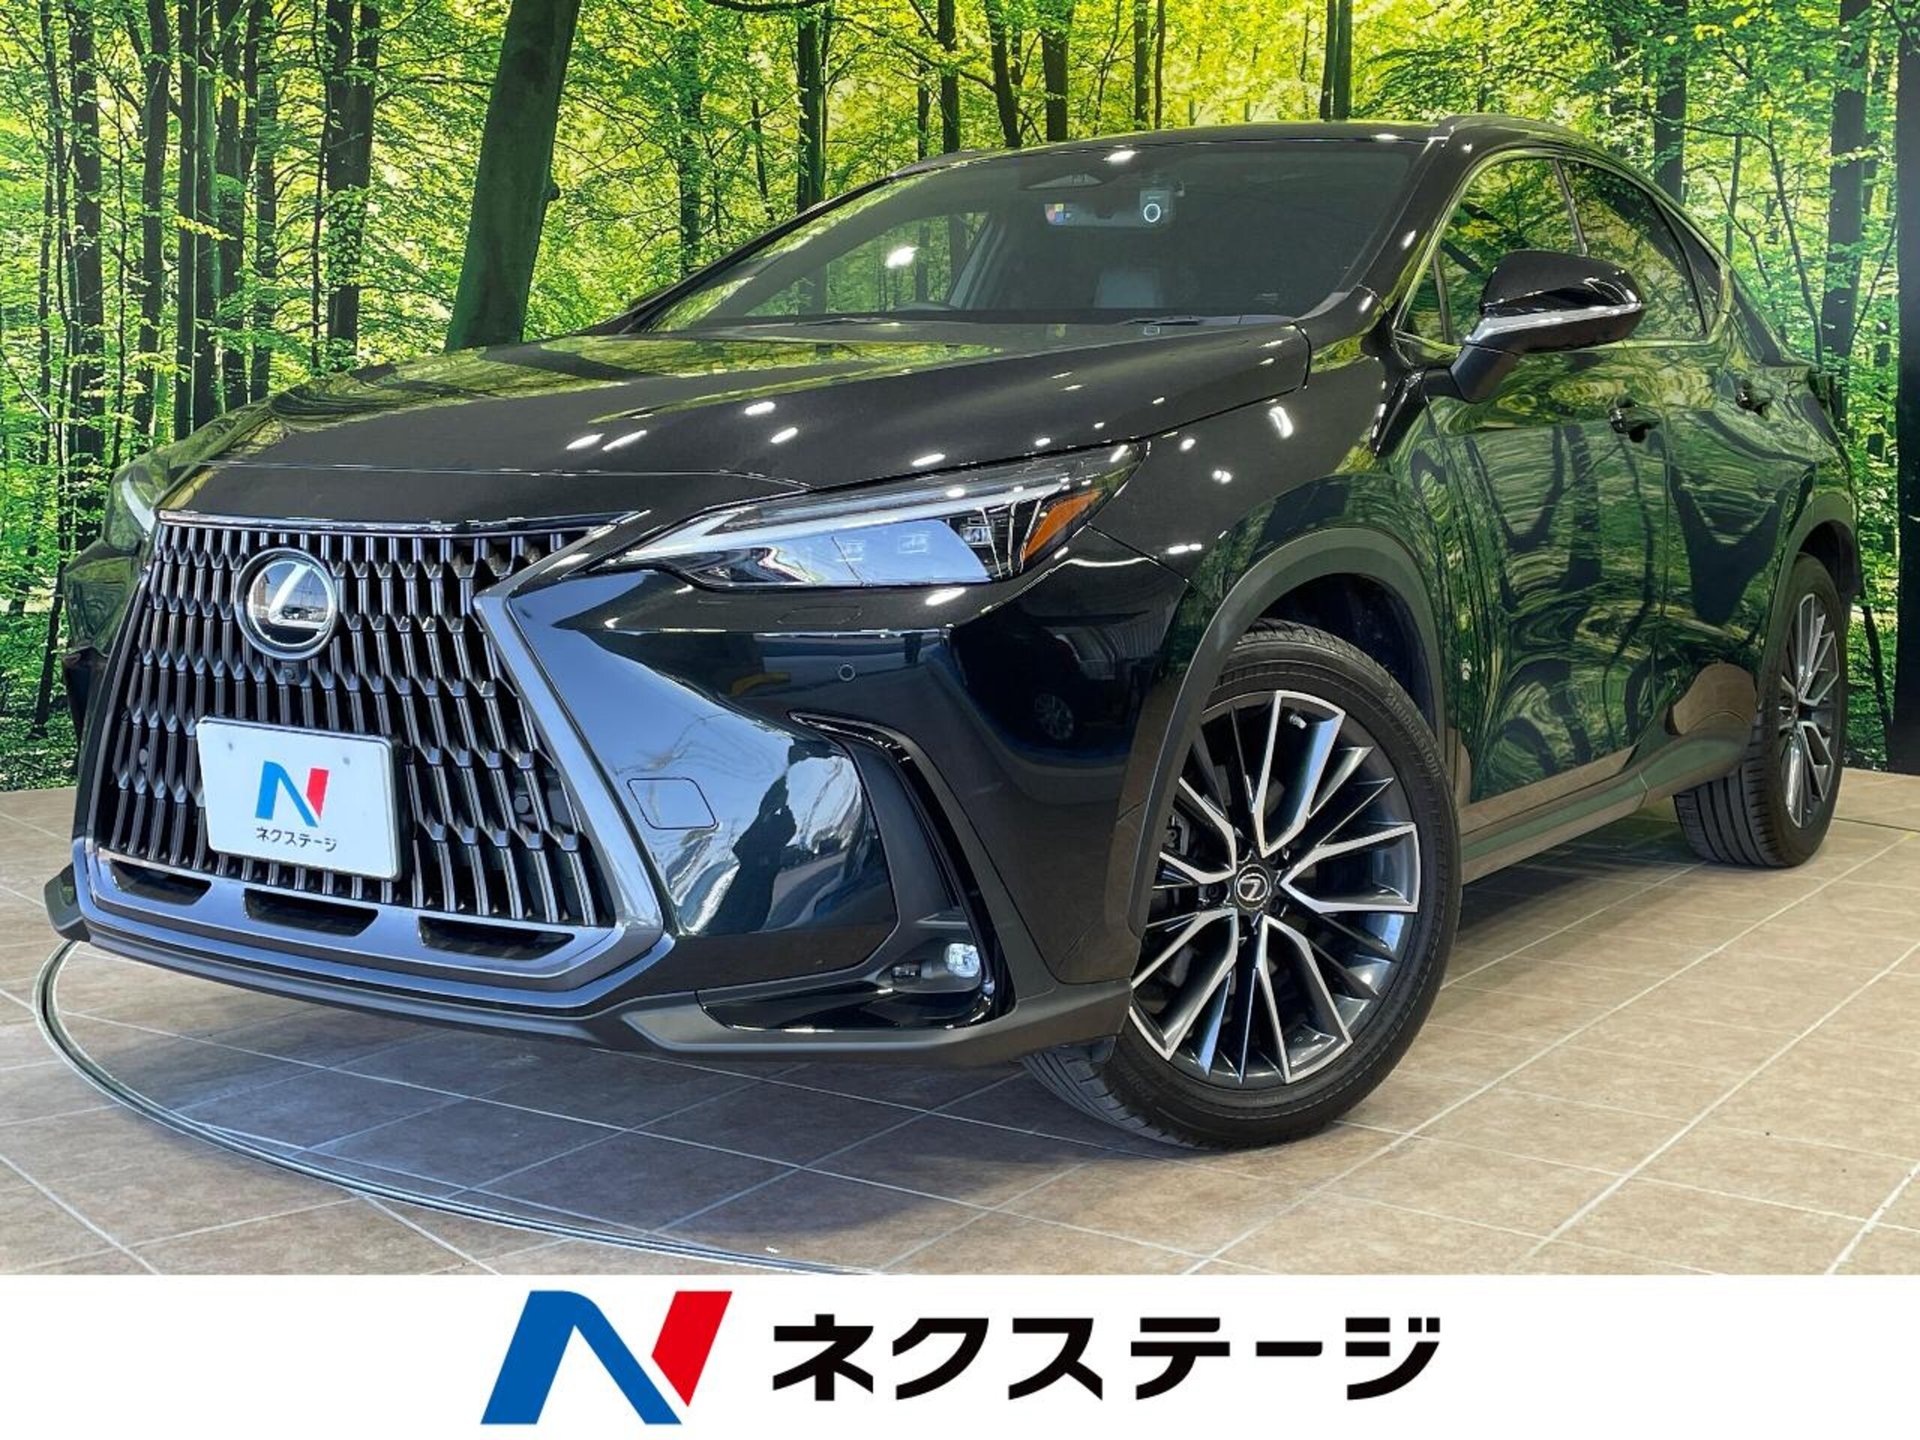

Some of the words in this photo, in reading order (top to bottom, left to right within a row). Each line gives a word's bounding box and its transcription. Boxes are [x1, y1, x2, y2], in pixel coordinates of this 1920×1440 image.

[256, 826, 337, 852] ネクステージ
